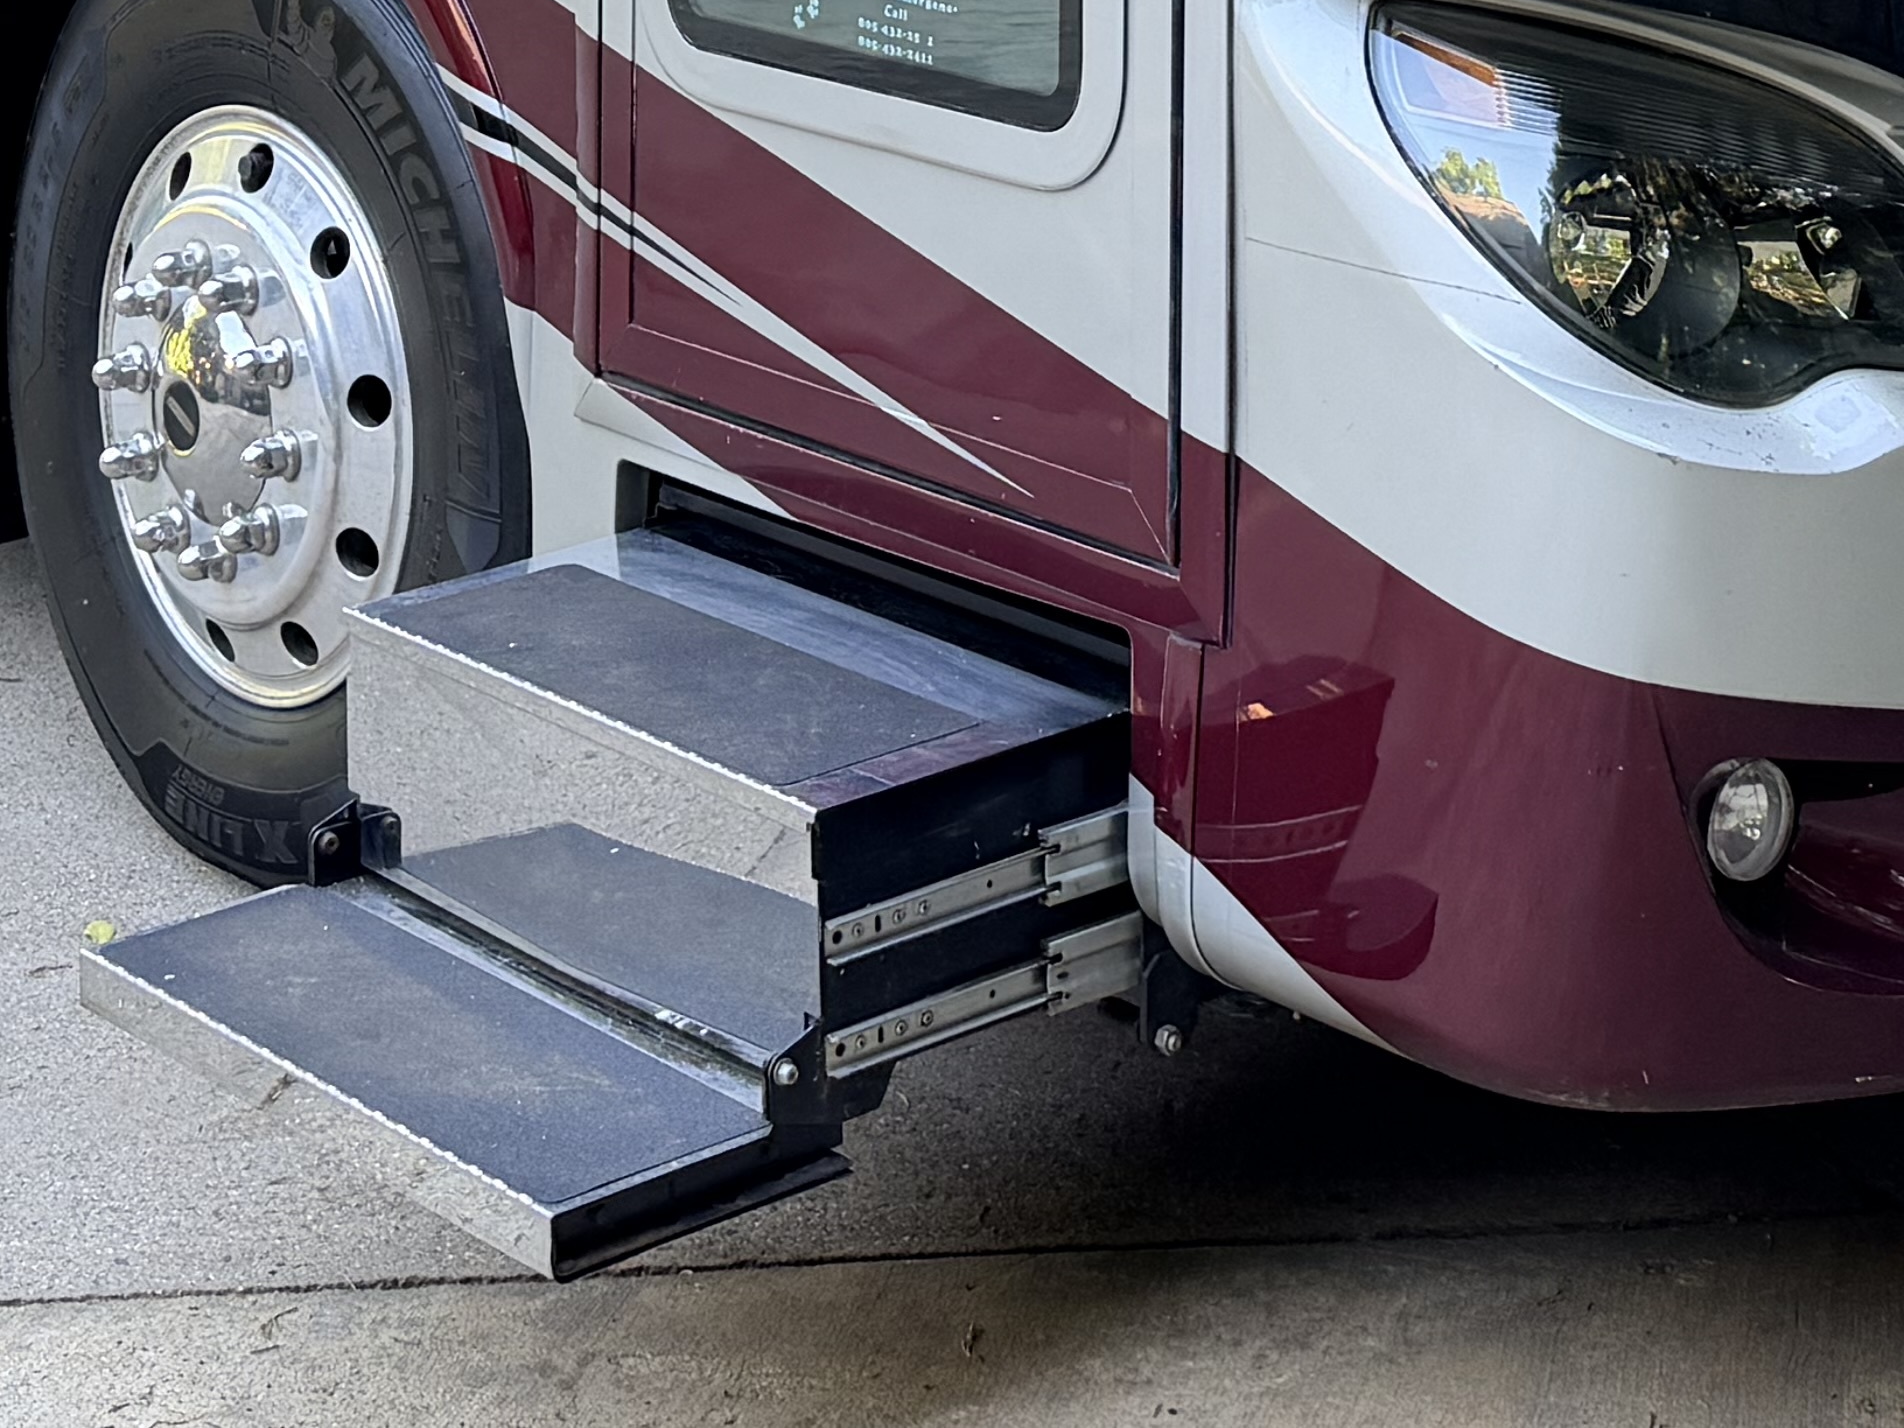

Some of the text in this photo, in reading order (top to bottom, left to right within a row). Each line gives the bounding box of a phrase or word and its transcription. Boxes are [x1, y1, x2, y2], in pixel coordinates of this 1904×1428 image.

[883, 3, 908, 22] Call
[344, 48, 491, 499] MICHELIN
[164, 782, 245, 856] LINE
